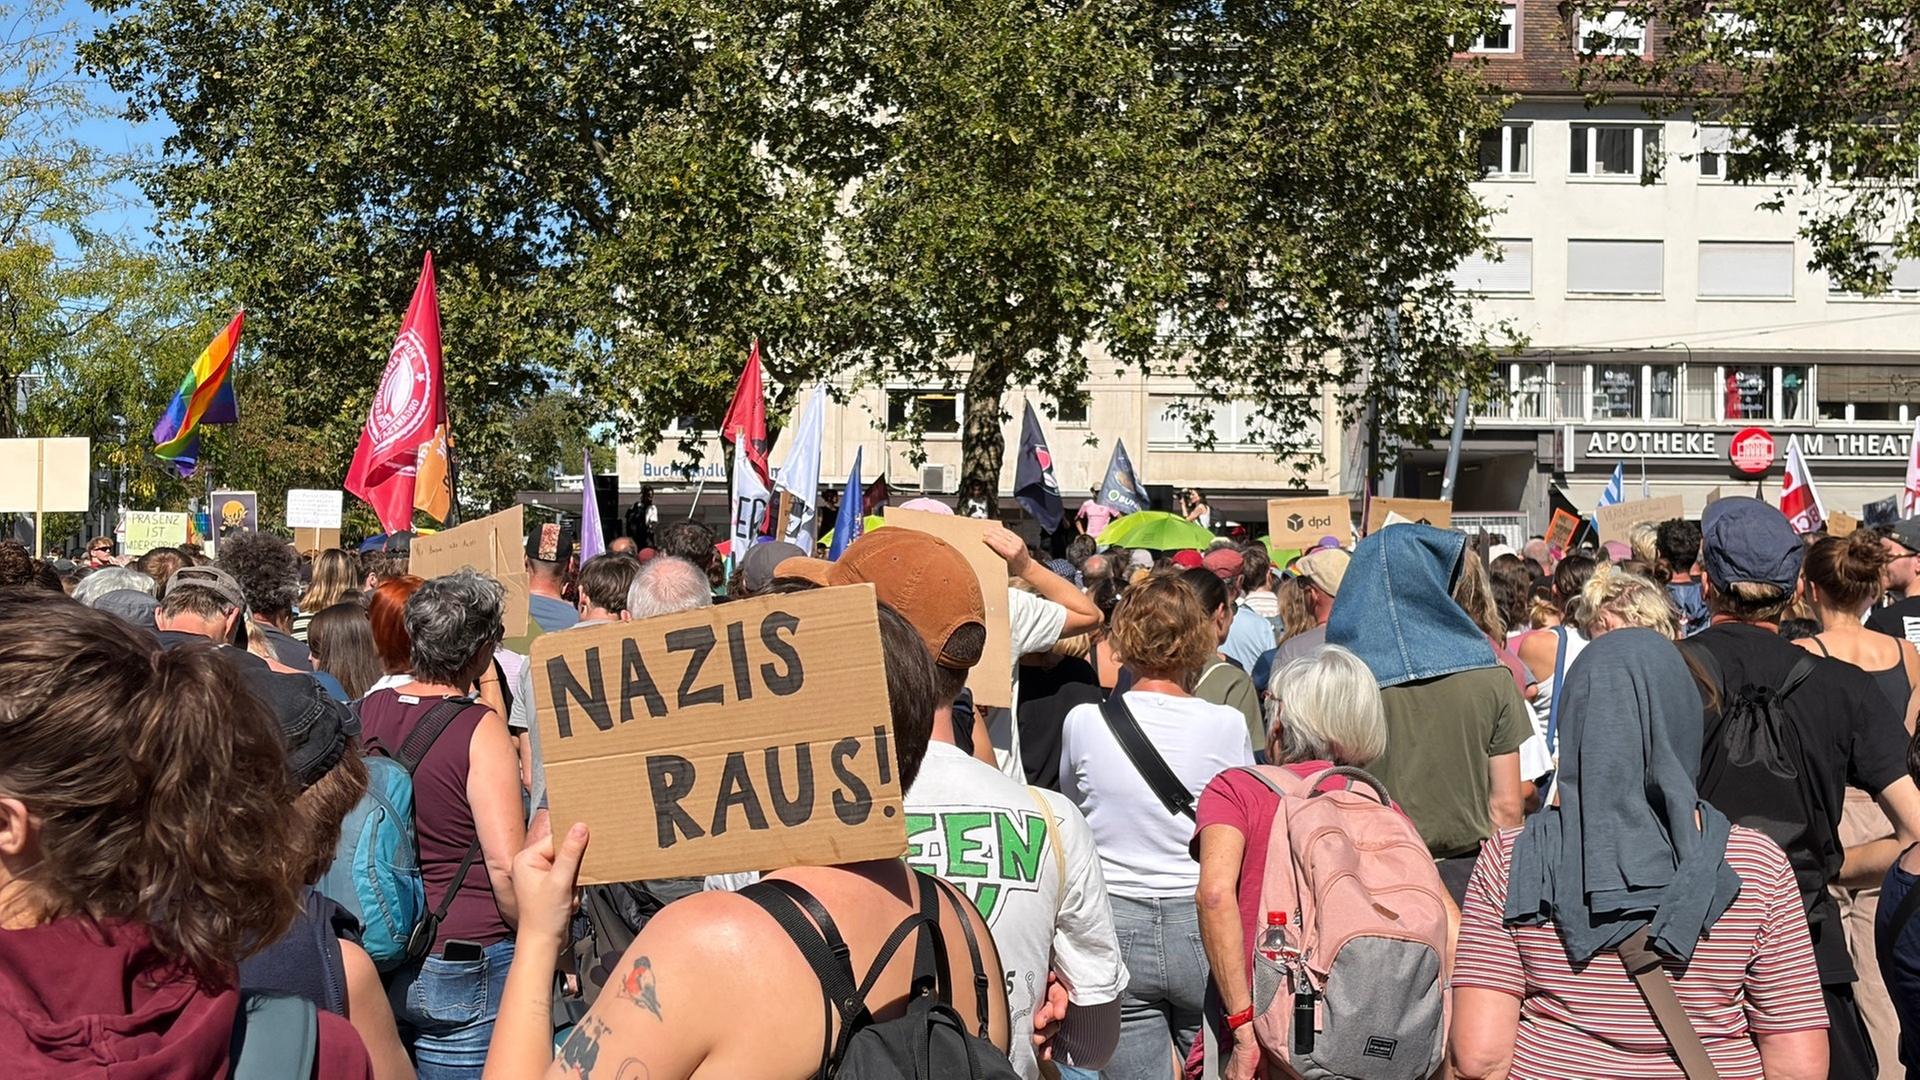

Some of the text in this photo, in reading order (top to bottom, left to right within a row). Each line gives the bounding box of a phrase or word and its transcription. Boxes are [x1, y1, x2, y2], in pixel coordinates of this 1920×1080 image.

[1587, 432, 1716, 454] APOTHEKE
[1835, 434, 1911, 455] THEAT
[146, 526, 166, 538] IST
[1308, 515, 1331, 529] dpd
[546, 610, 805, 739] NAZIS
[645, 725, 896, 849] RAUS!
[905, 812, 1048, 883] EEN
